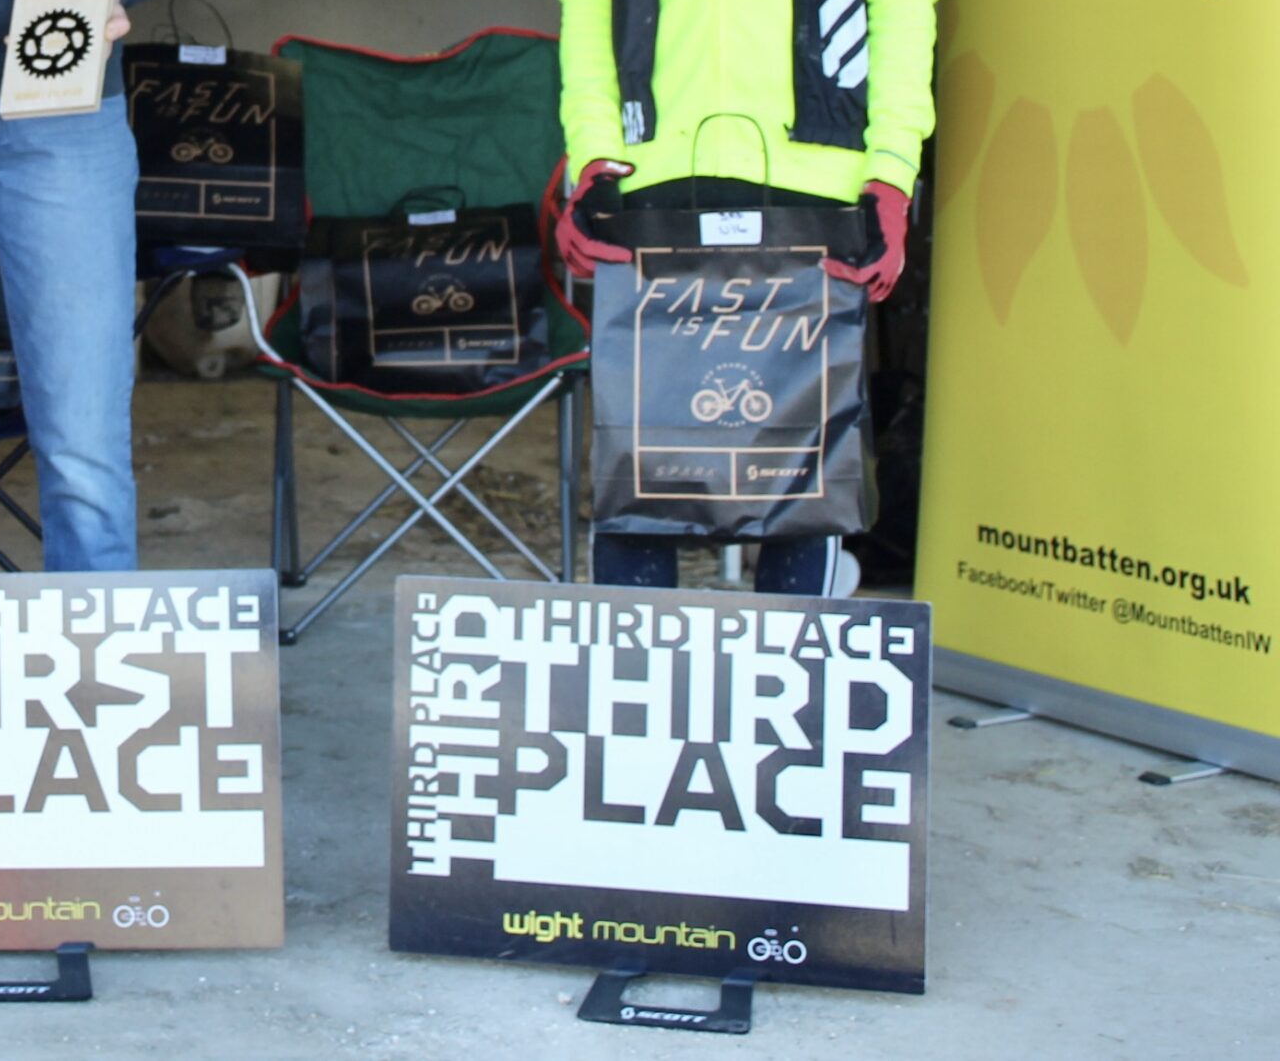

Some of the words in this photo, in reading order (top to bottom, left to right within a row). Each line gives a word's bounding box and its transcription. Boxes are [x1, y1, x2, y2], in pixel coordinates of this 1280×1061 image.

[637, 278, 794, 314] FAST
[672, 316, 704, 336] IS
[701, 315, 825, 352] FUN
[977, 524, 1251, 605] mountbatten.org.uk
[63, 588, 260, 633] PLACE
[500, 601, 689, 649] THIRD
[715, 610, 914, 659] PLACE
[957, 560, 1107, 614] Facebook/Twitter
[1112, 598, 1272, 654] @MountbattenIW
[499, 638, 913, 754] THIRD
[498, 732, 912, 842] PLACE
[503, 911, 583, 942] wight
[593, 920, 736, 950] mountain
[636, 1011, 708, 1022] SCOTT
